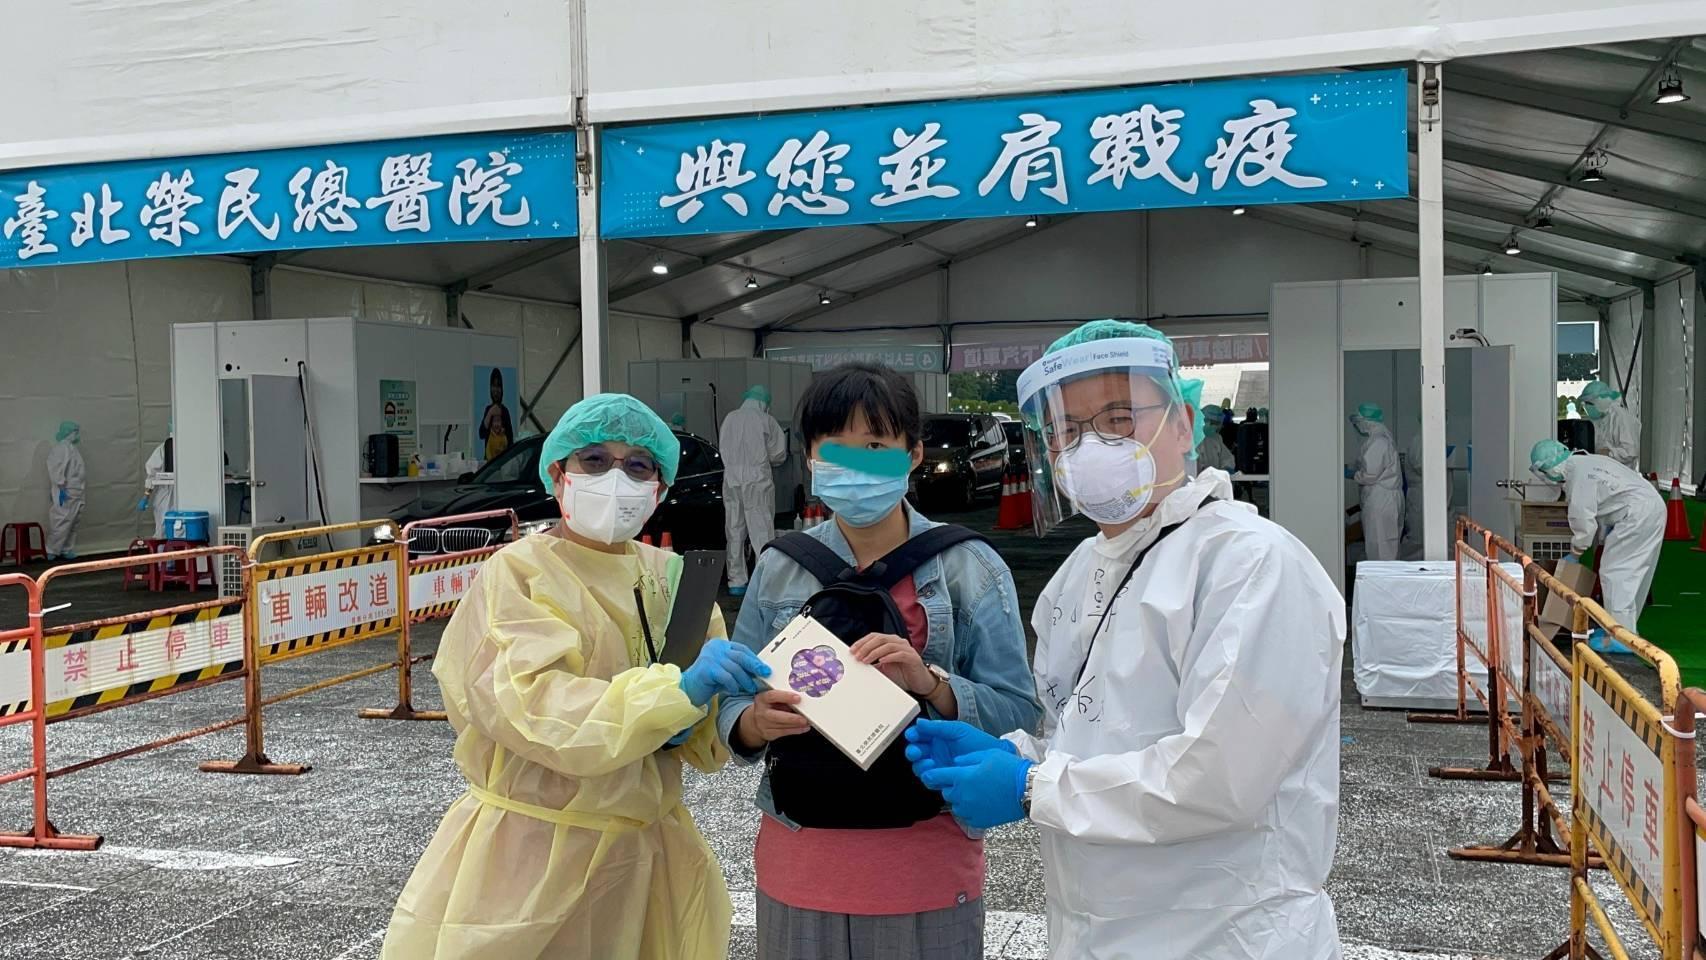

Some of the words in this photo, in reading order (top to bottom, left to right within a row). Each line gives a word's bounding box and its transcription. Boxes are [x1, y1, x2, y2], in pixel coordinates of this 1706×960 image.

[3, 151, 531, 260] 臺北榮民總醫院
[659, 99, 1328, 224] 與您並肩戰疫
[63, 621, 231, 683] 禁止停車
[270, 572, 389, 628] 車輛改道
[1583, 703, 1660, 861] 禁止停車
